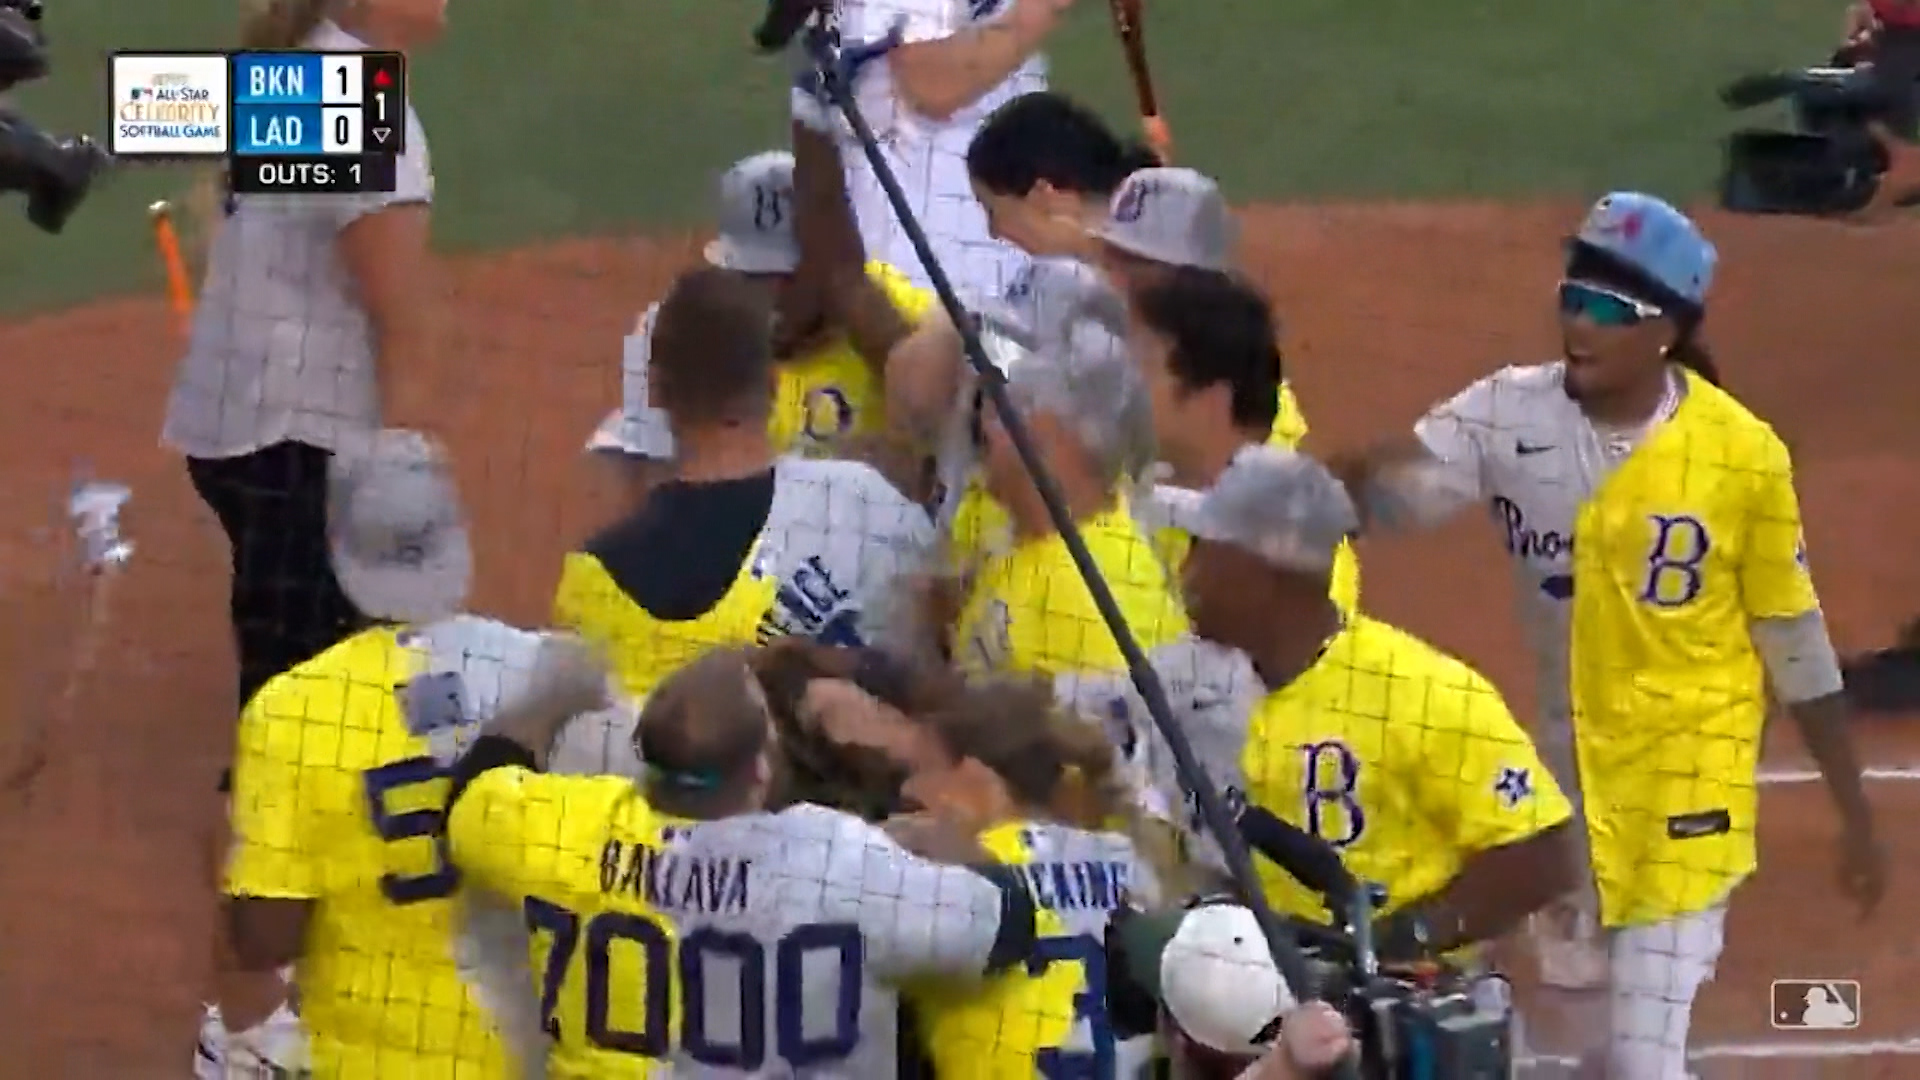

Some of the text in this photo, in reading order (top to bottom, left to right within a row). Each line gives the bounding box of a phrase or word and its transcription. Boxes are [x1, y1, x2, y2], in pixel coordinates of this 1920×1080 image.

[1643, 514, 1710, 607] B
[1298, 740, 1365, 848] B
[599, 838, 749, 912] BAKLAVA
[523, 894, 864, 1074] 7000
